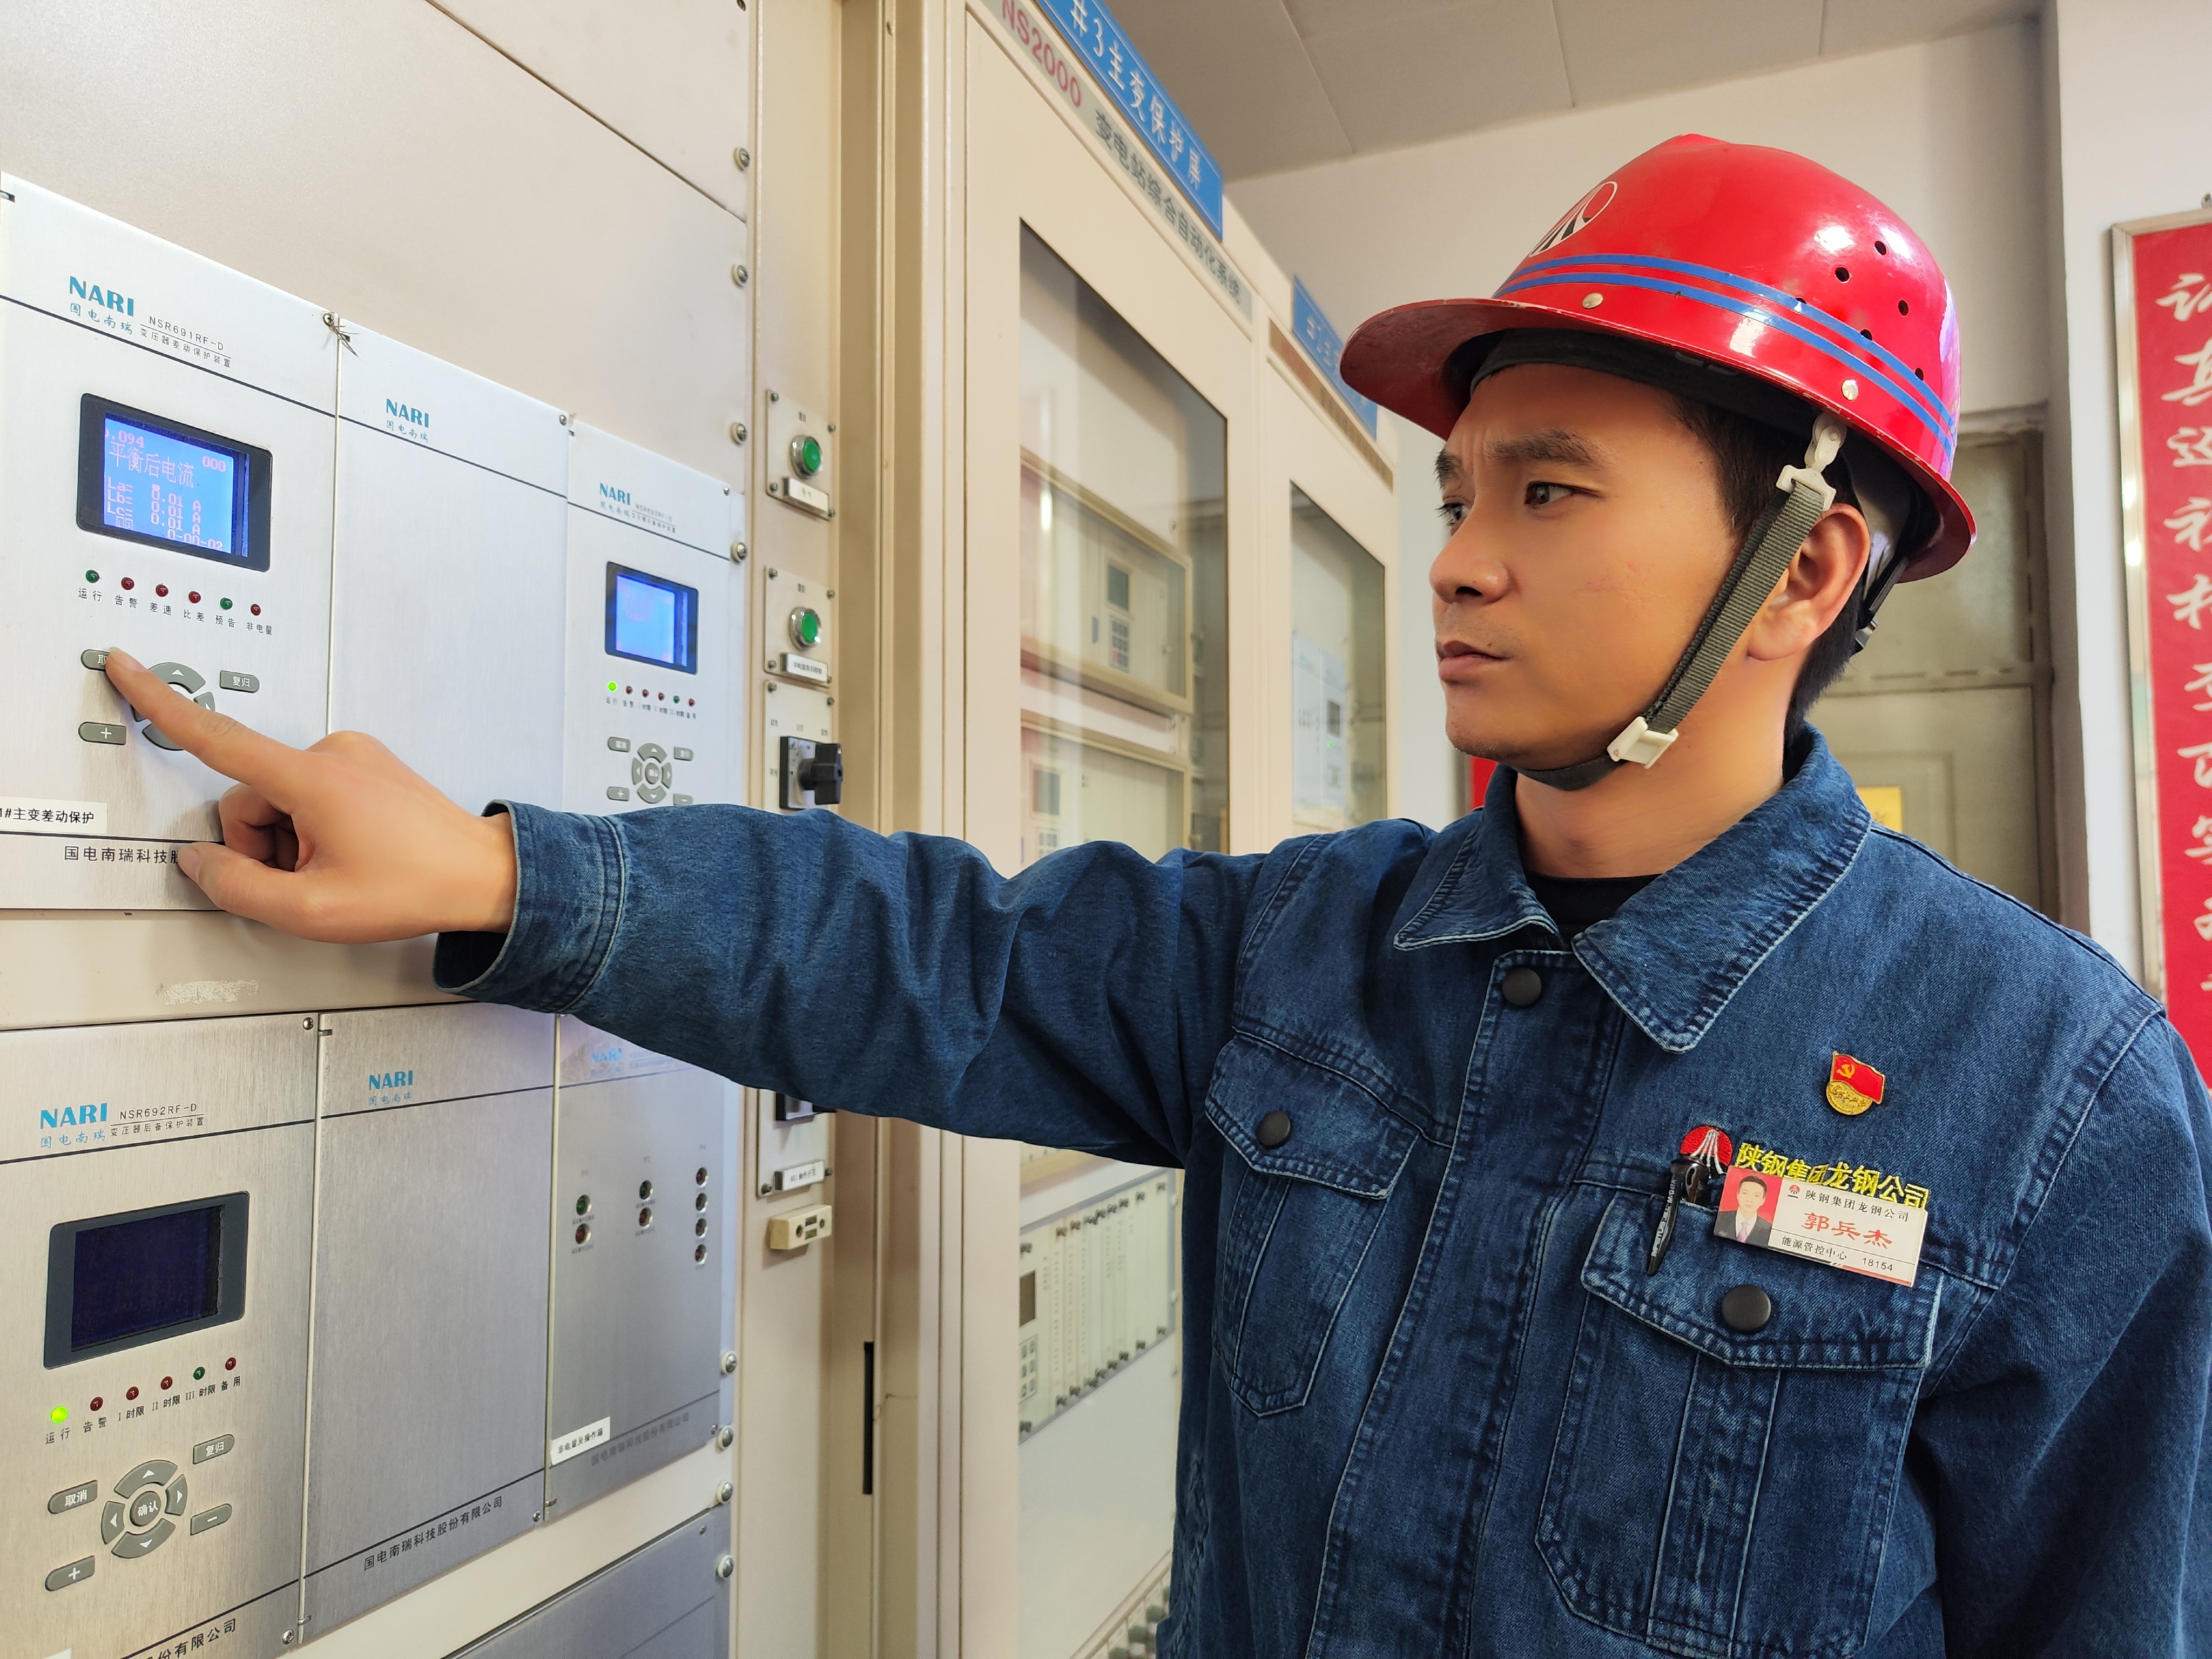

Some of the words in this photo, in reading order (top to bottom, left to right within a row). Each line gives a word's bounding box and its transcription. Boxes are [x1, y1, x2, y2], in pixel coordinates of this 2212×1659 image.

[1002, 0, 1082, 107] NS2000
[1095, 109, 1240, 305] 变电站综合自动化系统
[69, 275, 134, 318] NARI
[70, 302, 133, 335] 国电南瑞
[149, 316, 224, 351] NSR691RF-D
[140, 328, 231, 368] 变压器差动保护装置
[386, 398, 429, 428] NARI
[109, 440, 194, 488] 平衡后电流
[599, 482, 630, 506] NARI
[78, 587, 103, 602] 运行
[114, 595, 138, 609] 告警
[149, 602, 172, 616] 差速
[183, 609, 205, 622] 比差
[215, 615, 236, 628] 预告
[246, 622, 273, 636] 非电量
[232, 676, 251, 688] 复归
[369, 1070, 413, 1091] NARI
[40, 1102, 107, 1129] NARI
[110, 1117, 204, 1137] 变压器后备保护装置
[119, 1103, 198, 1120] NSR692RF-D
[40, 1128, 106, 1149] 国电南瑞
[1735, 1142, 1930, 1210] 陕钢集团龙钢公司
[1805, 1189, 1910, 1223] 陕钢集团龙钢公司
[1800, 1212, 1892, 1250] 郭兵杰
[1781, 1236, 1847, 1261] 能源管控中心
[1862, 1257, 1893, 1272] 18154
[45, 1427, 71, 1445] 运行
[83, 1416, 107, 1433] 告警
[126, 1405, 145, 1420] 时限
[163, 1394, 180, 1408] 时限
[199, 1384, 216, 1398] 时限
[221, 1375, 241, 1392] 备用
[205, 1441, 225, 1457] 复归
[65, 1489, 88, 1507] 取消
[137, 1500, 159, 1517] 确认
[364, 1495, 502, 1571] 国电南瑞科技股份有限公司
